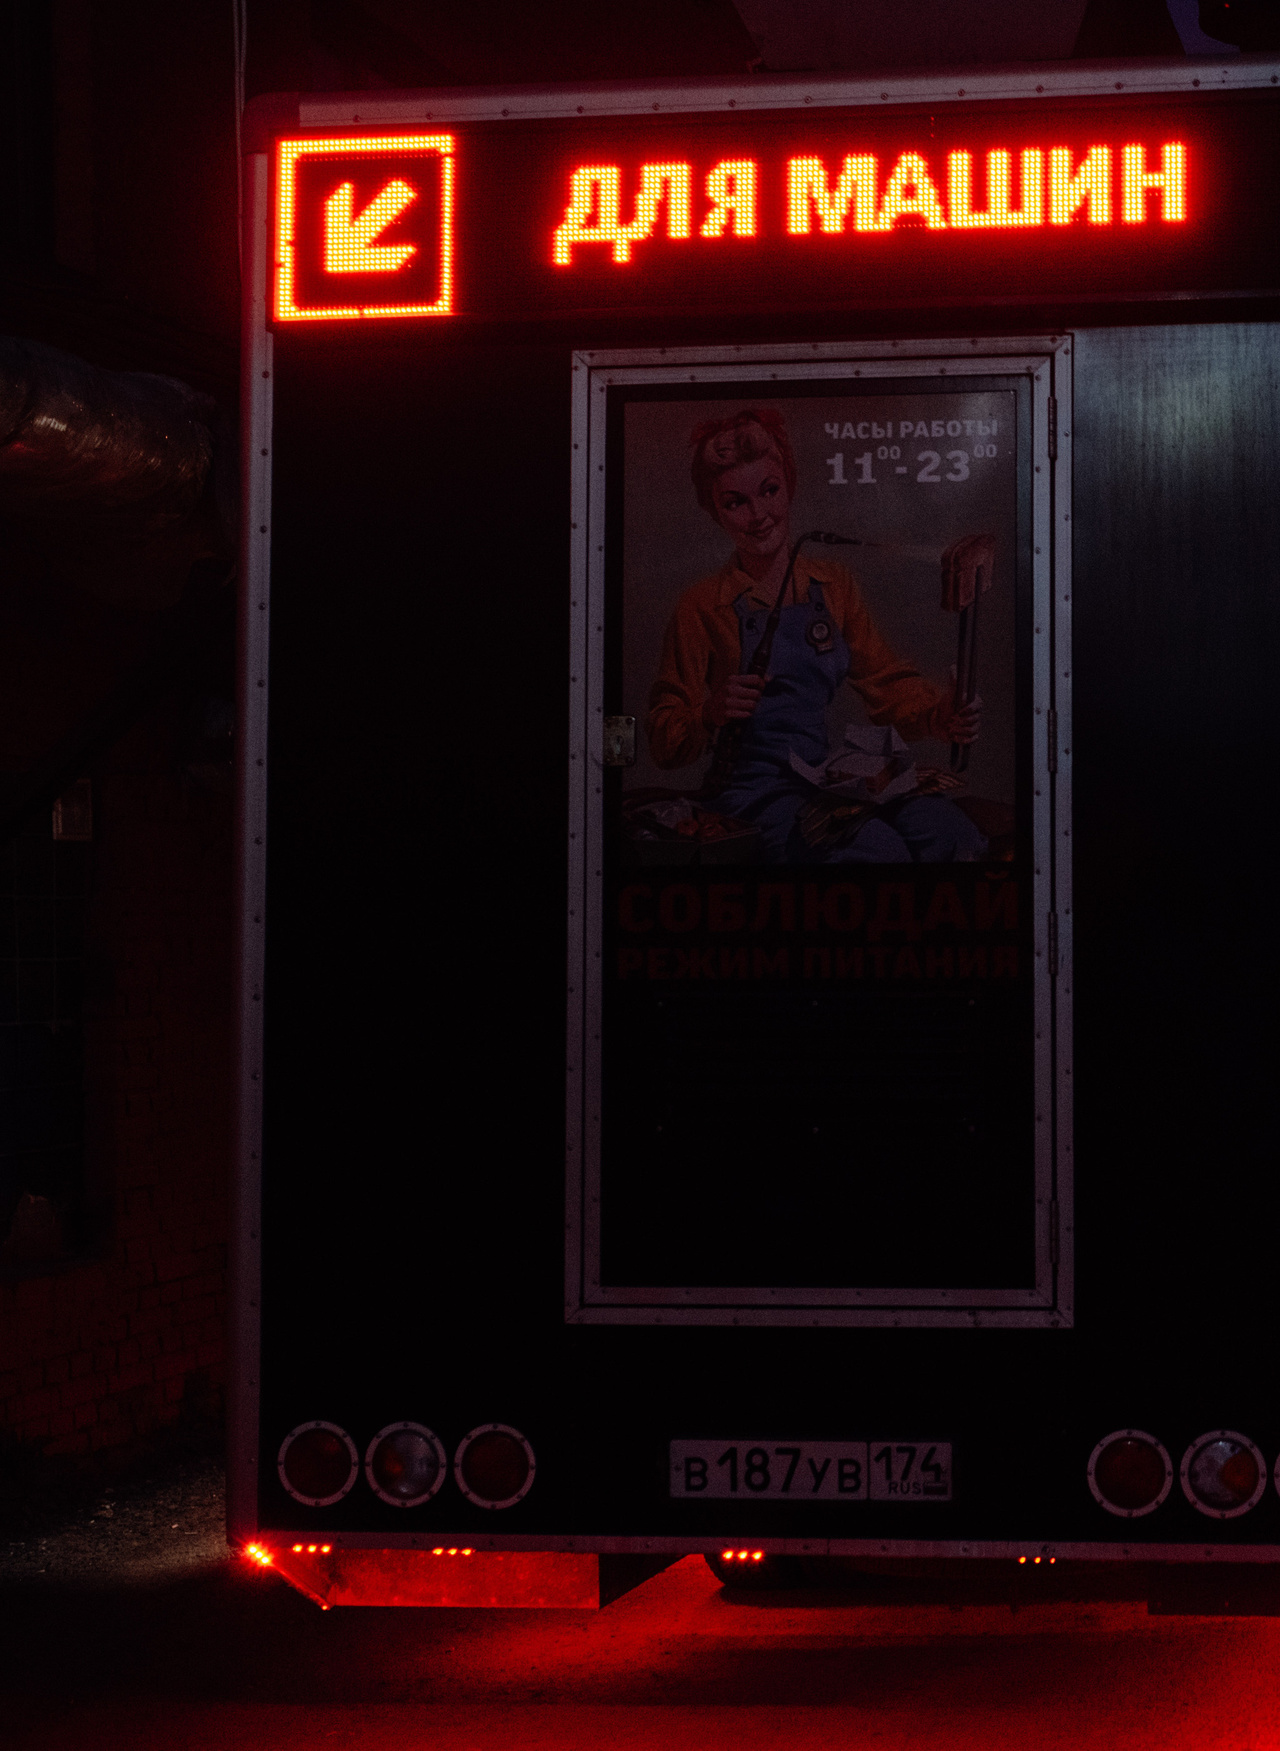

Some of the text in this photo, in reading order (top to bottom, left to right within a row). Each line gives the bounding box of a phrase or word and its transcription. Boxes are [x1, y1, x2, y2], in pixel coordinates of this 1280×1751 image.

[552, 141, 1188, 265] ДЛЯ МАШИН
[824, 419, 998, 440] ЧАСЫ РАБОТЫ
[617, 870, 1019, 942] СОБЛЮДАЙ
[616, 945, 1019, 980] РЕЖИМ ПИТАНИЯ
[874, 1446, 941, 1482] 174
[888, 1480, 921, 1495] RUS
